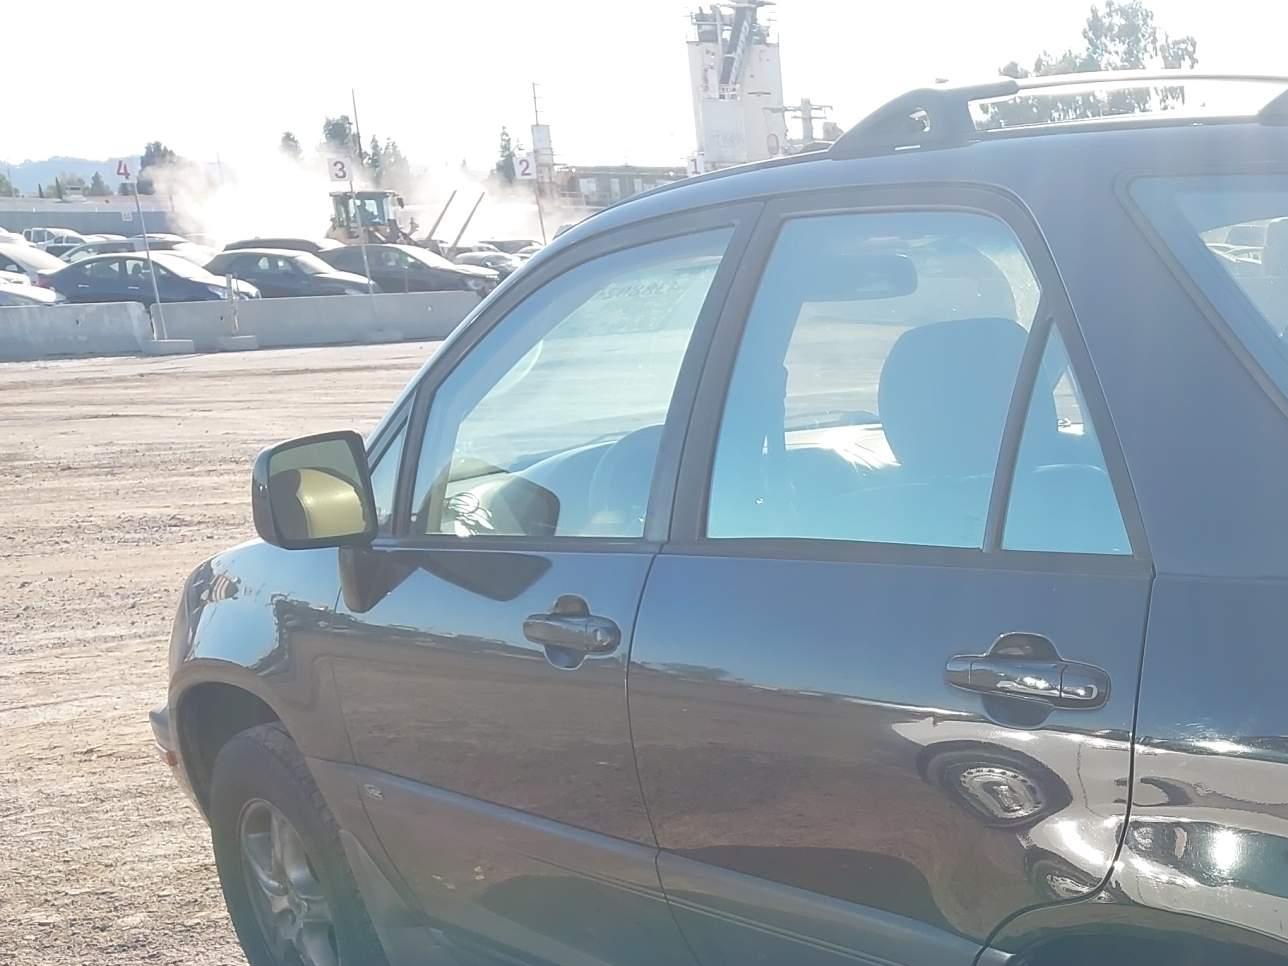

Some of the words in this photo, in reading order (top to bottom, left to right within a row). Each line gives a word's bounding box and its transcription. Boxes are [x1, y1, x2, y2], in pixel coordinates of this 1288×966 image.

[116, 159, 131, 180] 4
[332, 160, 348, 179] 3
[518, 158, 532, 177] 2
[690, 157, 702, 175] 1
